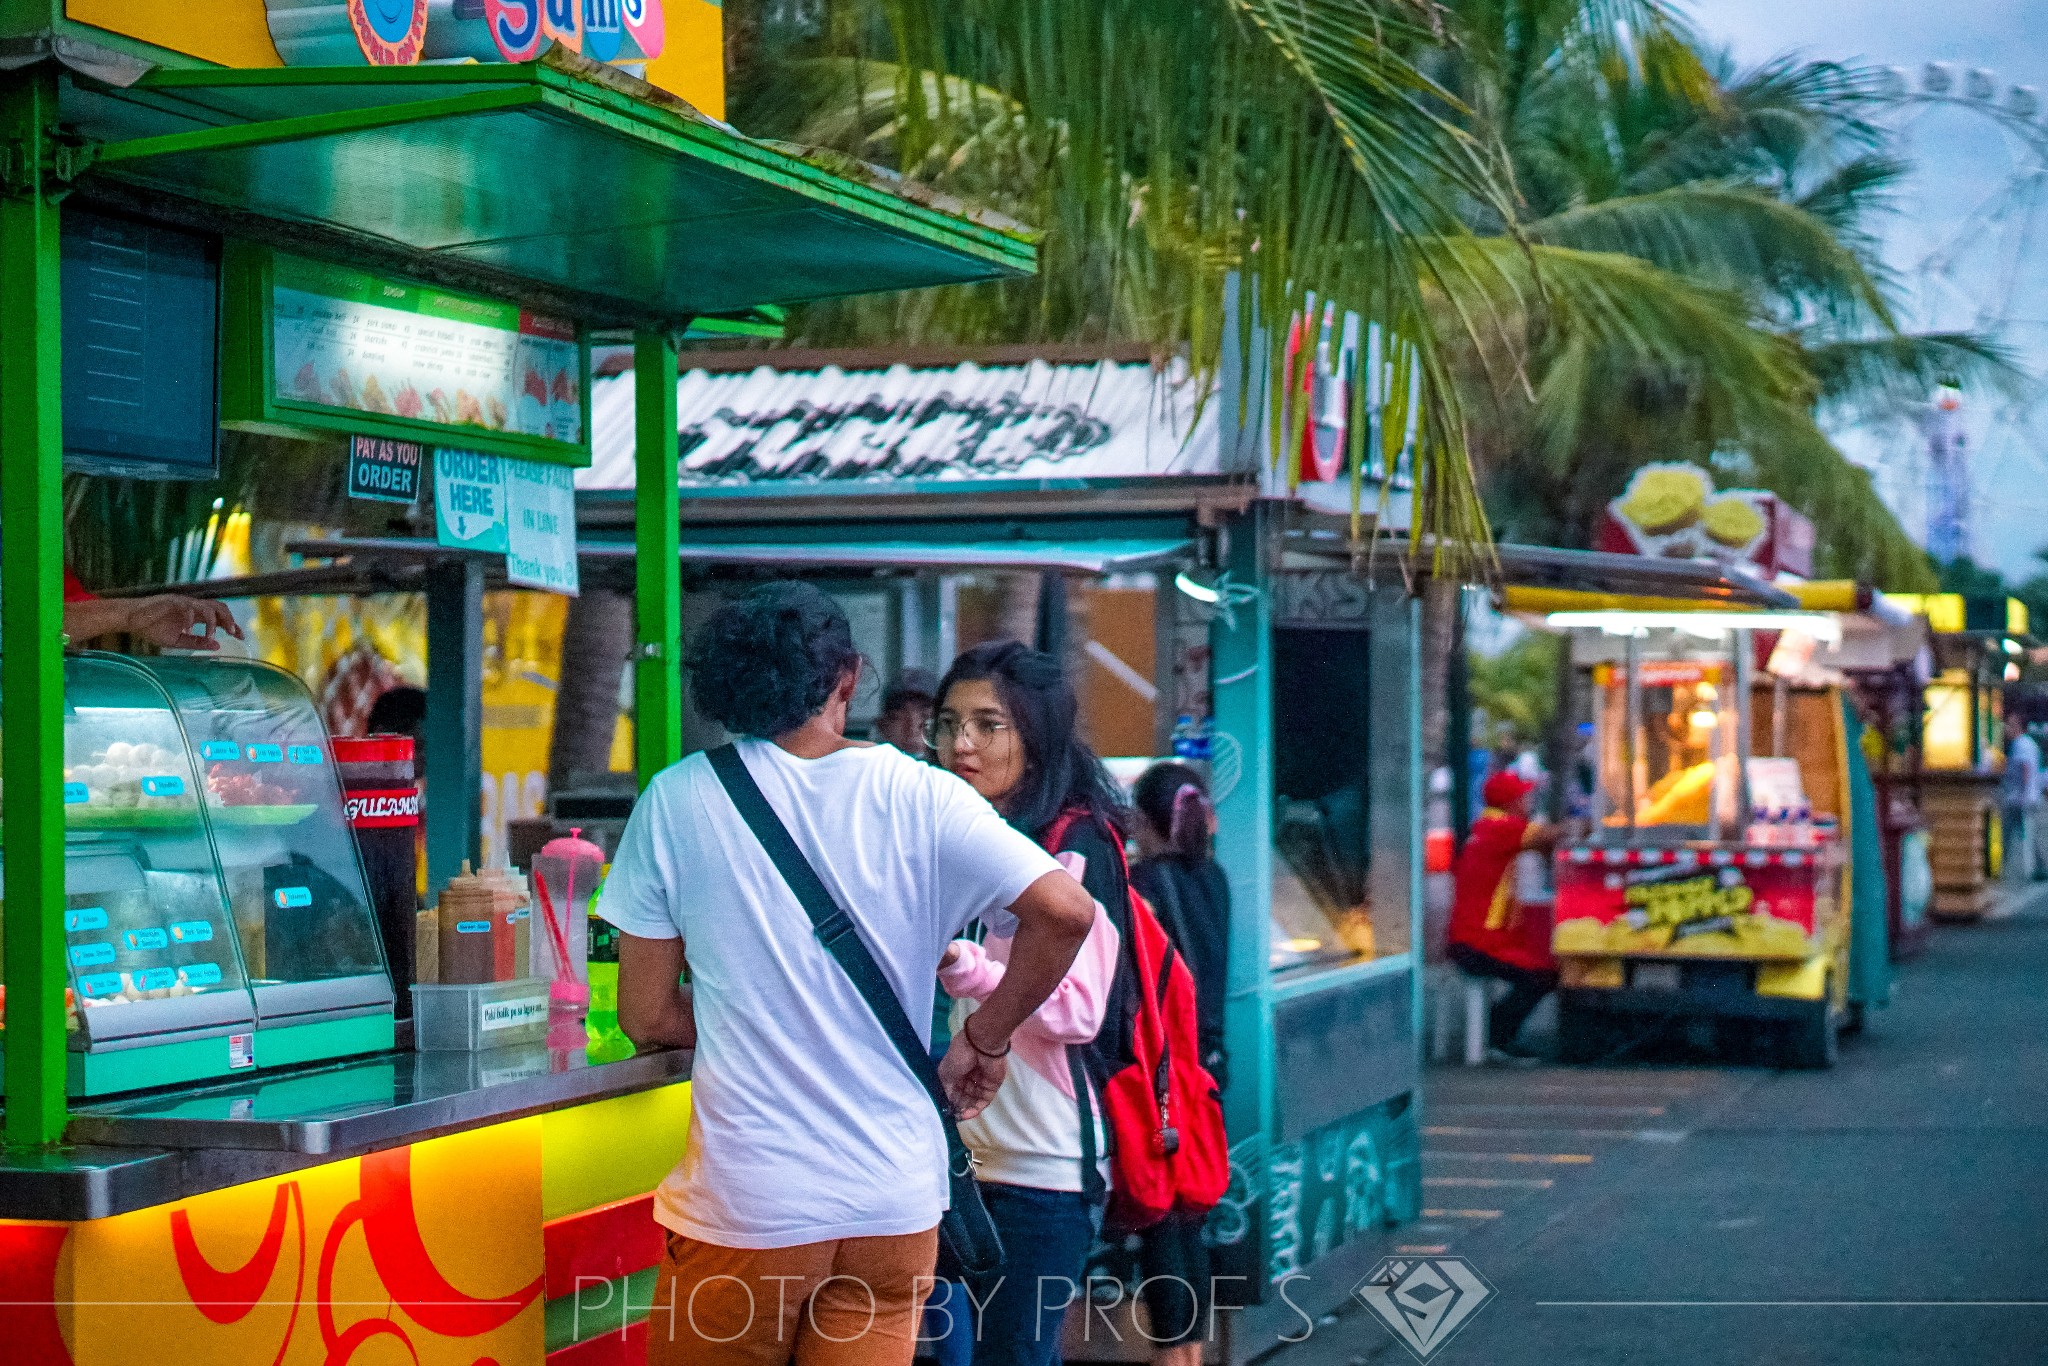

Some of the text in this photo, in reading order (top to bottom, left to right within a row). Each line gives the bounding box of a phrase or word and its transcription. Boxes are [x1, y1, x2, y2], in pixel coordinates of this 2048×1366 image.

[356, 436, 418, 466] PAY AS YOU
[358, 462, 412, 494] ORDER
[439, 449, 501, 485] ORDER
[449, 482, 495, 517] HERE
[523, 508, 559, 535] IN LINE
[509, 552, 542, 578] Thank
